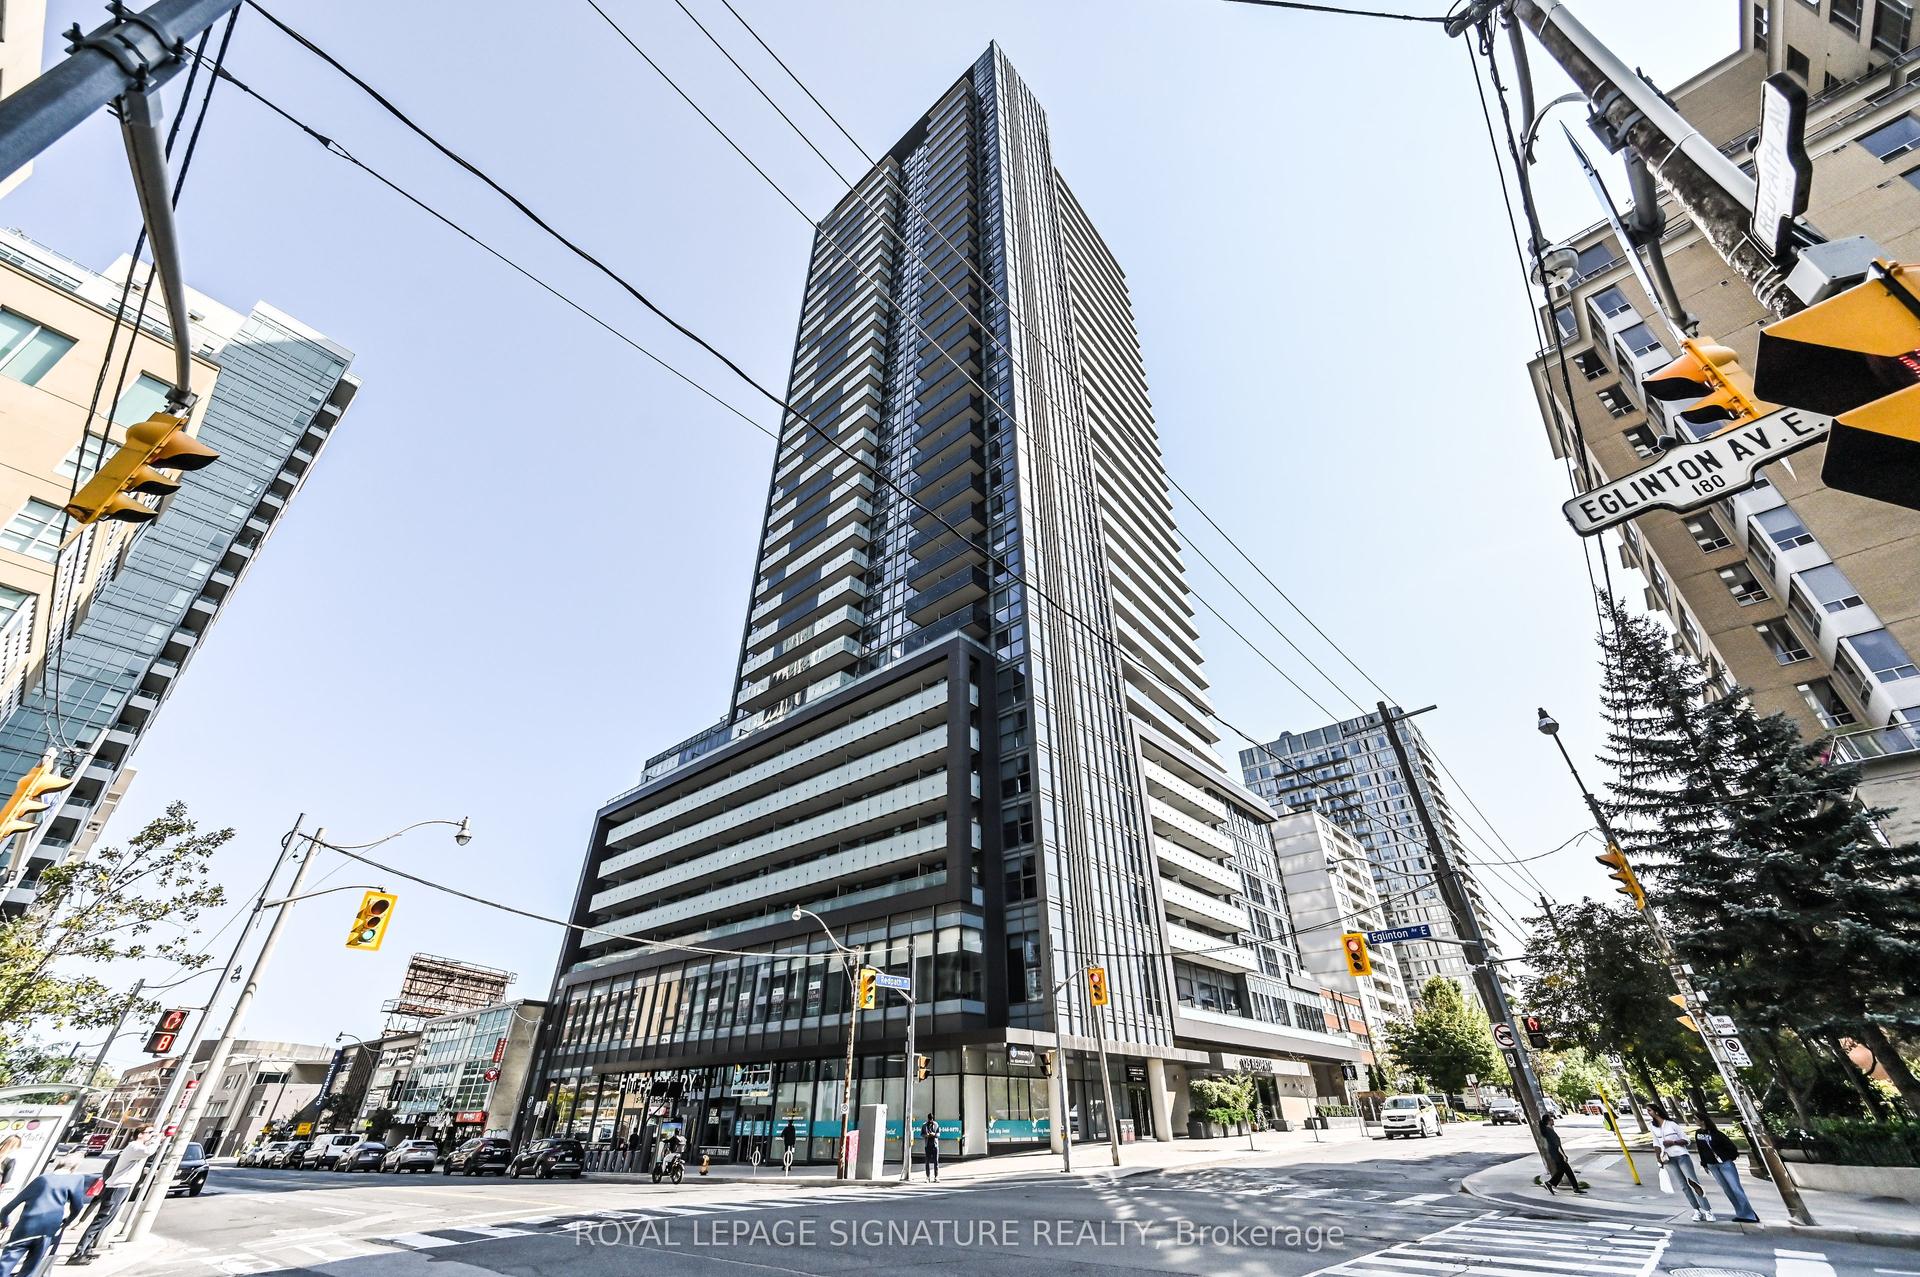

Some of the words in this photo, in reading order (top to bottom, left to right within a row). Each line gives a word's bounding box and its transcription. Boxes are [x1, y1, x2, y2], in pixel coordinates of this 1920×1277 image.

[1758, 138, 1782, 238] REDPATH
[1578, 449, 1723, 524] EGLINTON
[1691, 474, 1726, 497] 180
[1371, 929, 1409, 943] Eglinton
[1421, 926, 1427, 935] E
[880, 976, 903, 987] Redpath
[157, 1034, 172, 1051] 8
[619, 1073, 637, 1094] FIT
[639, 1073, 698, 1097] FARY
